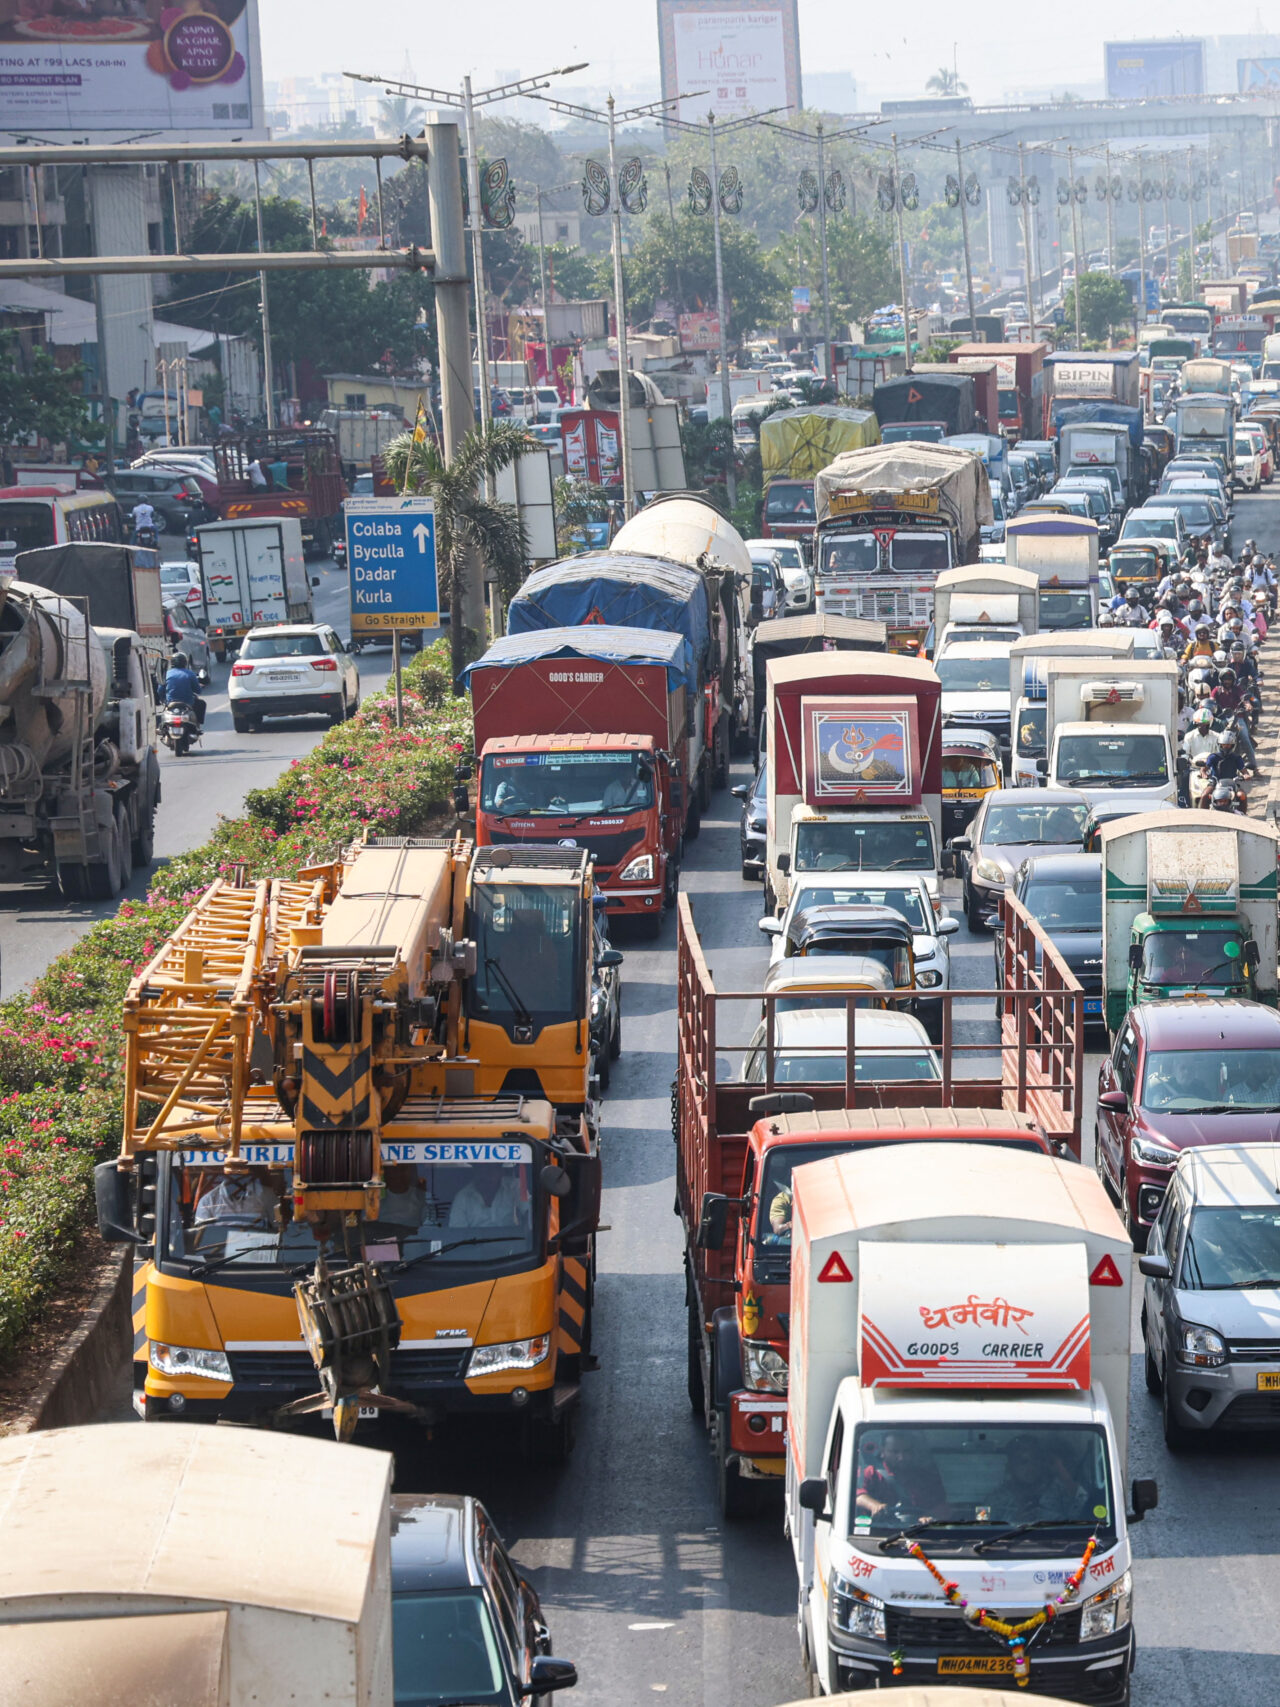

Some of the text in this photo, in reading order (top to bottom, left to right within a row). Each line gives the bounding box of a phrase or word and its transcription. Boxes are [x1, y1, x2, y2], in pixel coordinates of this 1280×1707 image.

[182, 26, 215, 35] SAPNO
[176, 37, 192, 46] KA
[187, 48, 213, 56] APNO
[28, 59, 40, 67] AT
[66, 58, 92, 67] LACS
[14, 75, 52, 84] PAYMENT
[55, 75, 79, 84] PLAN
[1058, 370, 1110, 381] BIPIN
[353, 522, 402, 536] Colaba
[354, 544, 404, 561] Byculla
[355, 567, 396, 581] Dadar
[356, 589, 392, 603] Kurla
[365, 615, 426, 625] Go Straight
[550, 673, 604, 682] GOOD'S CARRIER
[424, 1145, 522, 1160] SERVICE
[919, 1294, 1034, 1336] धर्मवीर
[907, 1342, 1044, 1358] GOODS CARRIER
[848, 1555, 878, 1579] शुभ
[1089, 1555, 1115, 1582] लाभ
